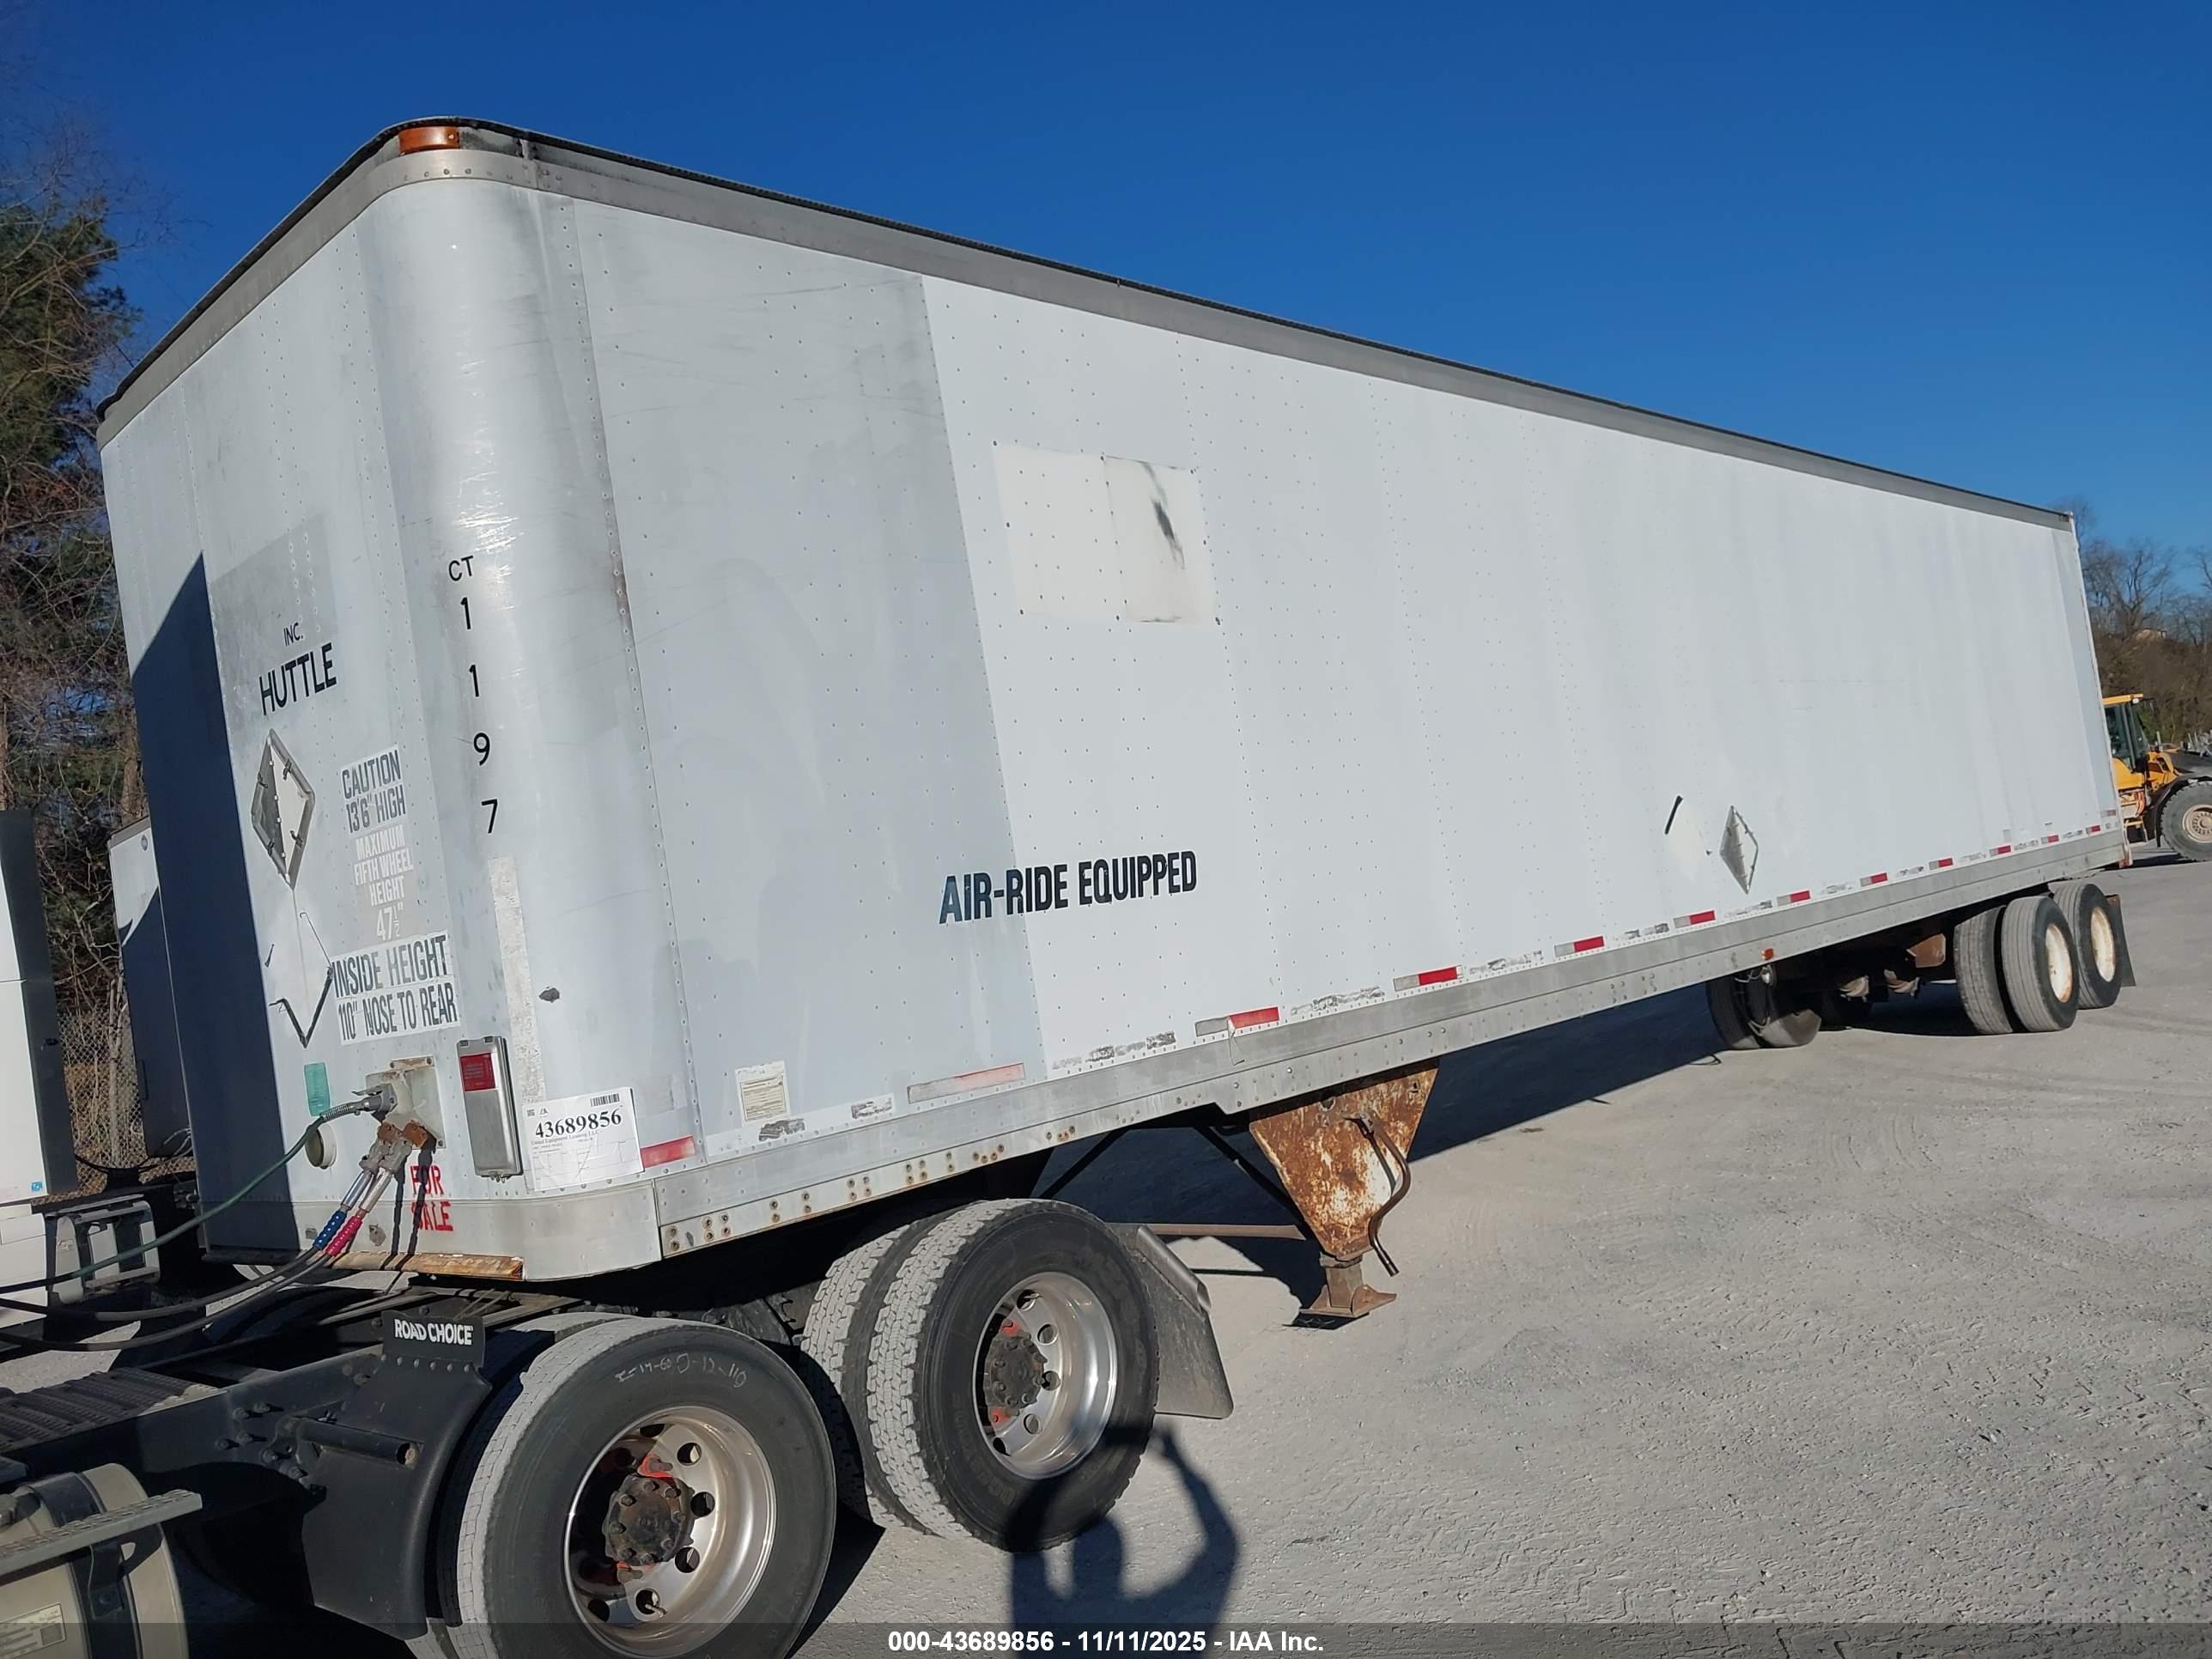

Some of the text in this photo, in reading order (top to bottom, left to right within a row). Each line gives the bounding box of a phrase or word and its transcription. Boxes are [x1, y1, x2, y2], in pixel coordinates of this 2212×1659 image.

[448, 555, 474, 581] CT
[283, 622, 303, 647] INC.
[258, 641, 337, 716] HUTTLE
[342, 749, 401, 799] CAUTION
[374, 784, 406, 823] HIGH
[355, 824, 405, 860] MAXIMUM
[354, 847, 414, 886] FIFTH WHEEL
[369, 875, 405, 907] HEIGHT
[939, 851, 1197, 925] AIR-RIDE EQUIPPED
[331, 933, 447, 999] INSIDE HEIGHT
[362, 994, 398, 1036] NOSE
[398, 989, 417, 1030] TO
[419, 981, 458, 1027] REAR
[535, 1107, 622, 1138] 43689856
[394, 1319, 474, 1346] ROAD CHOICE
